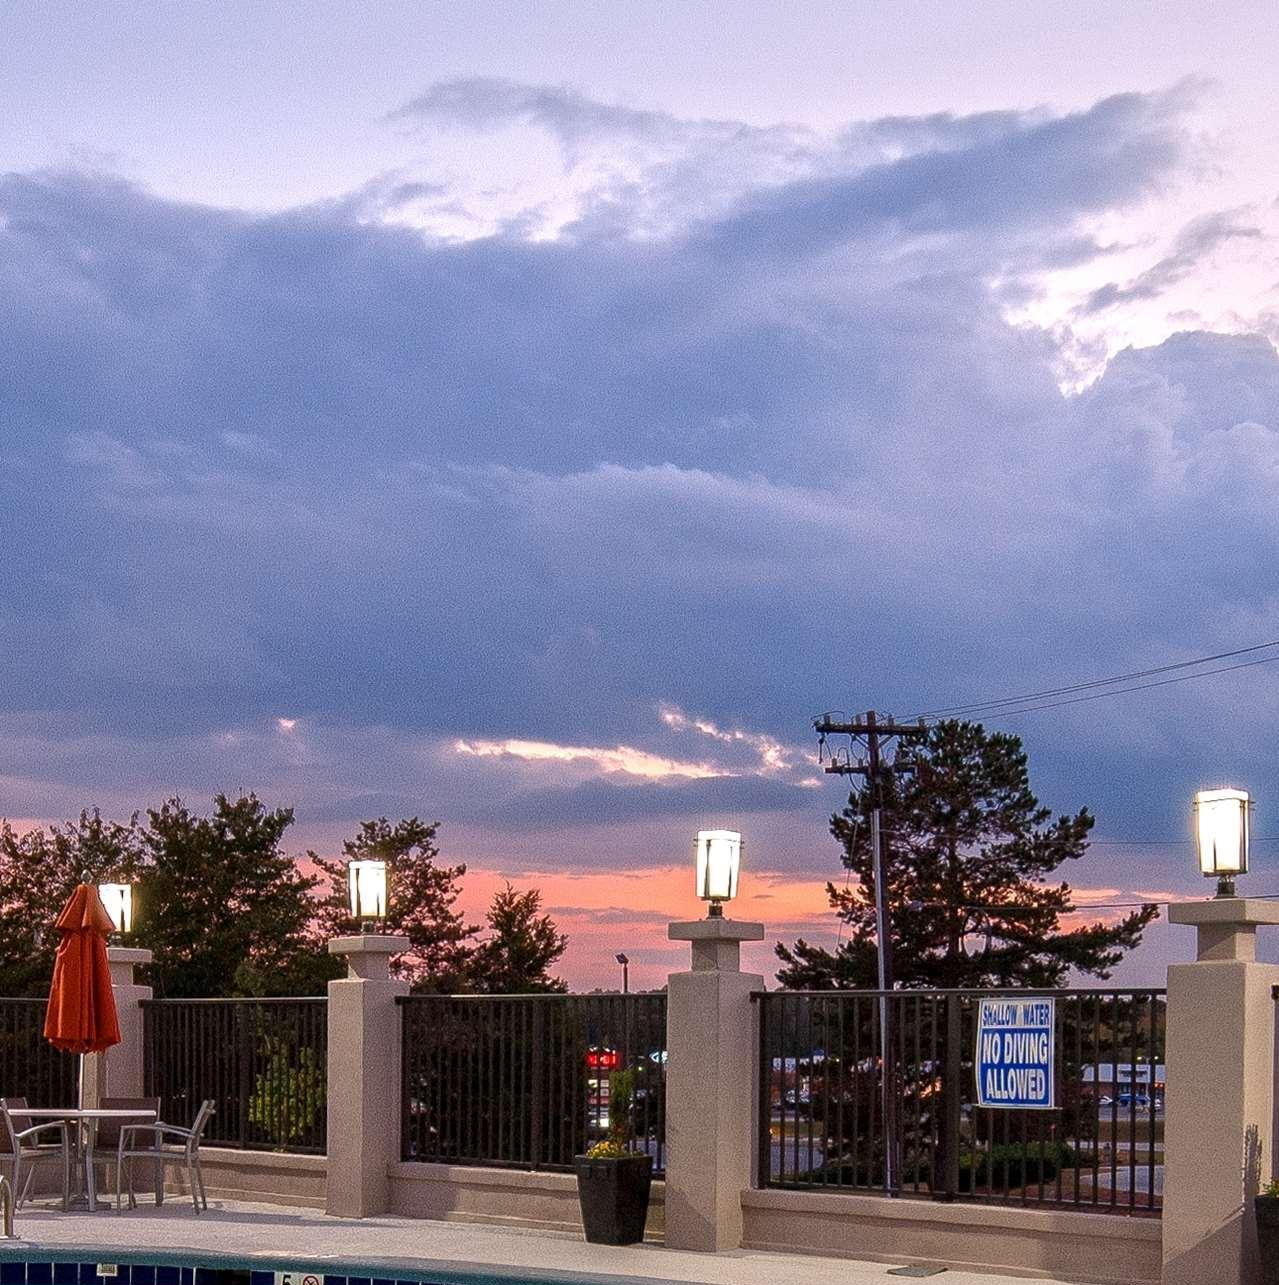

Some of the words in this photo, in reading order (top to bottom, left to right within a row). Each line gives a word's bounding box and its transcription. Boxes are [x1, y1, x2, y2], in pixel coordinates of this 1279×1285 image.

[983, 1004, 1017, 1027] SHALLOW
[1023, 1003, 1050, 1026] WATER
[982, 1033, 1000, 1065] NO
[1004, 1032, 1048, 1065] DIVING
[986, 1069, 1044, 1099] ALLOWED
